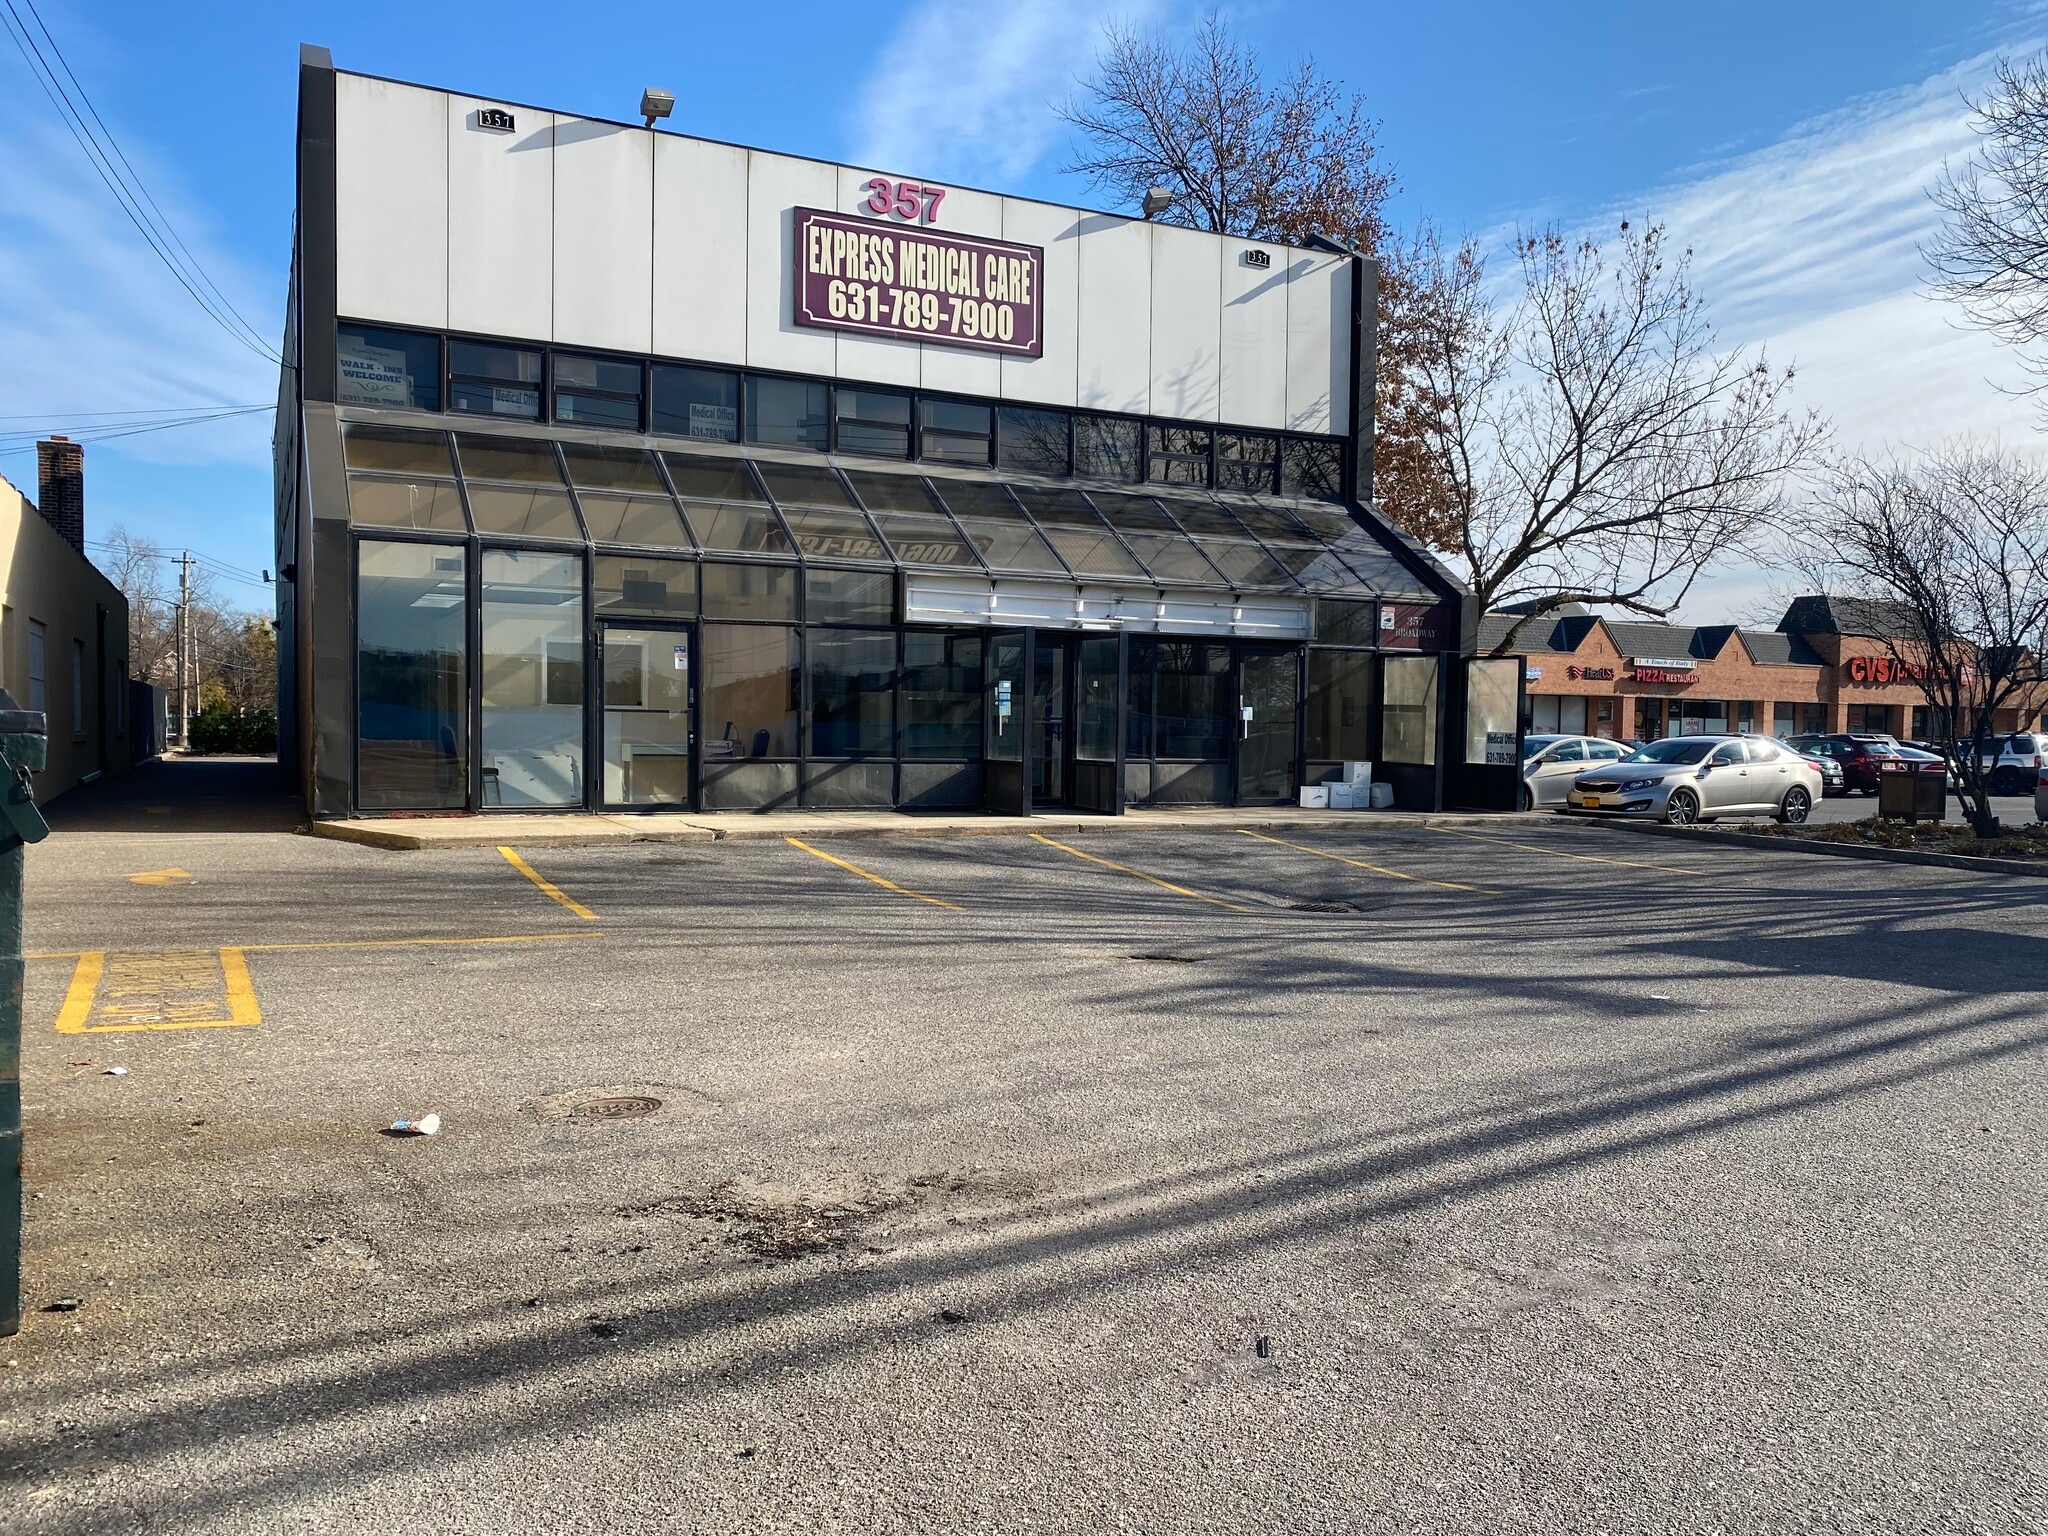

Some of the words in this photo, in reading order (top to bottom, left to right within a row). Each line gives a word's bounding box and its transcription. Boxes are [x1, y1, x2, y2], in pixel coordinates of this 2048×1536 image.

[485, 113, 510, 128] 357
[868, 177, 946, 222] 357
[809, 226, 894, 285] EXPRESS
[900, 240, 980, 298] MEDICAL
[985, 254, 1031, 305] CARE
[1251, 252, 1267, 265] 357
[828, 279, 1014, 341] 631-789-7900
[340, 359, 375, 371] WALK
[383, 365, 403, 374] INS
[342, 369, 402, 383] WELCOME
[495, 388, 522, 404] Medical
[691, 404, 716, 419] Medical
[716, 407, 736, 421] Office
[1406, 616, 1425, 627] 357
[1395, 627, 1436, 638] BROADWAY
[1636, 668, 1665, 682] PIZZA
[1666, 673, 1701, 684] RESTAURANT
[1487, 732, 1504, 744] Medical
